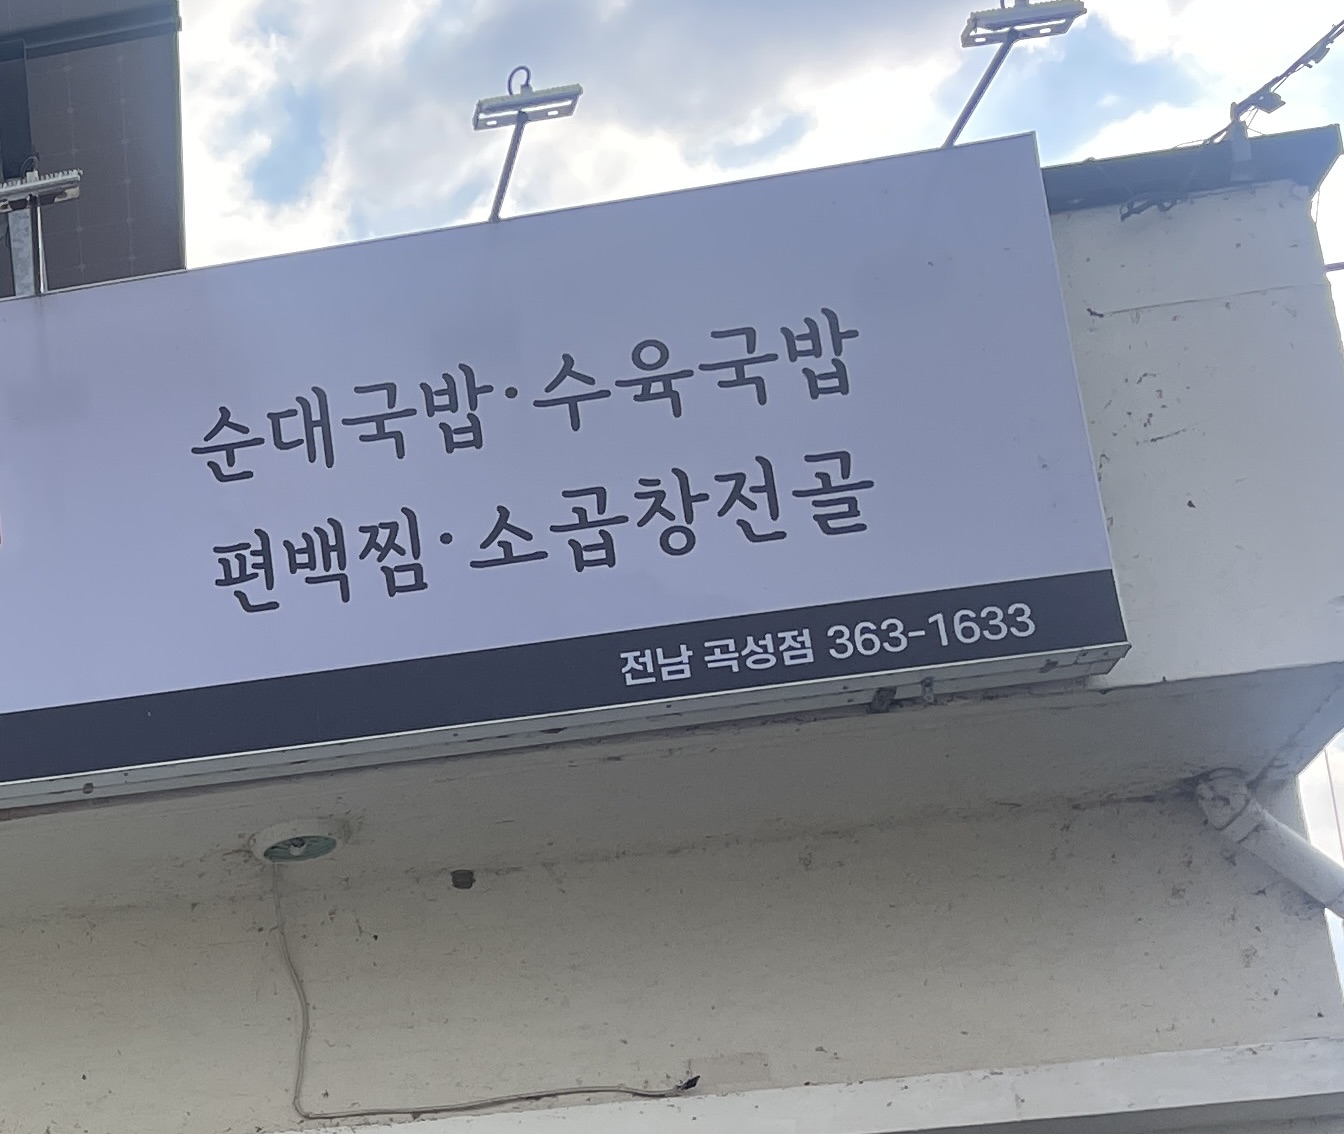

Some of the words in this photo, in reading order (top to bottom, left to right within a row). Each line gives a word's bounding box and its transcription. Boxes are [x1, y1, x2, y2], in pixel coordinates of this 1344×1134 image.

[619, 642, 695, 687] 전남
[703, 627, 815, 674] 곡성점
[825, 601, 1037, 660] 363-1633
